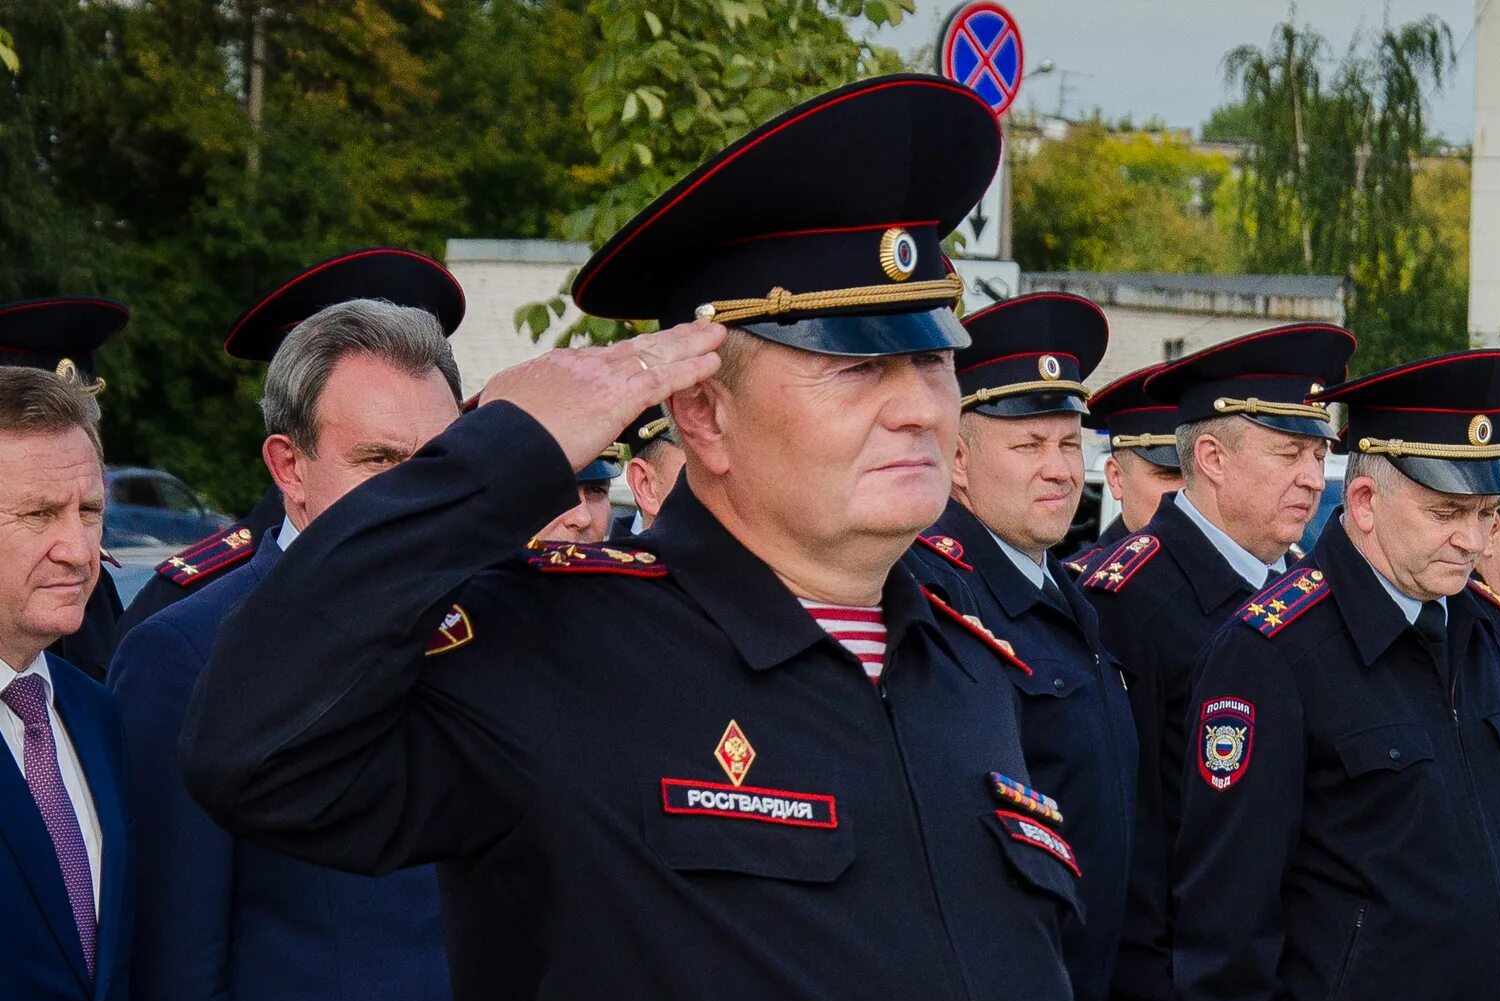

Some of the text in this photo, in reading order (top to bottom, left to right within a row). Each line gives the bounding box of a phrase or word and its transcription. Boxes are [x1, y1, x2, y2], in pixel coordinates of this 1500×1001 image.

[1206, 700, 1250, 715] ПОЛИЦИЯ
[1211, 775, 1231, 789] МВД
[687, 789, 813, 820] РОСГВАРДИЯ
